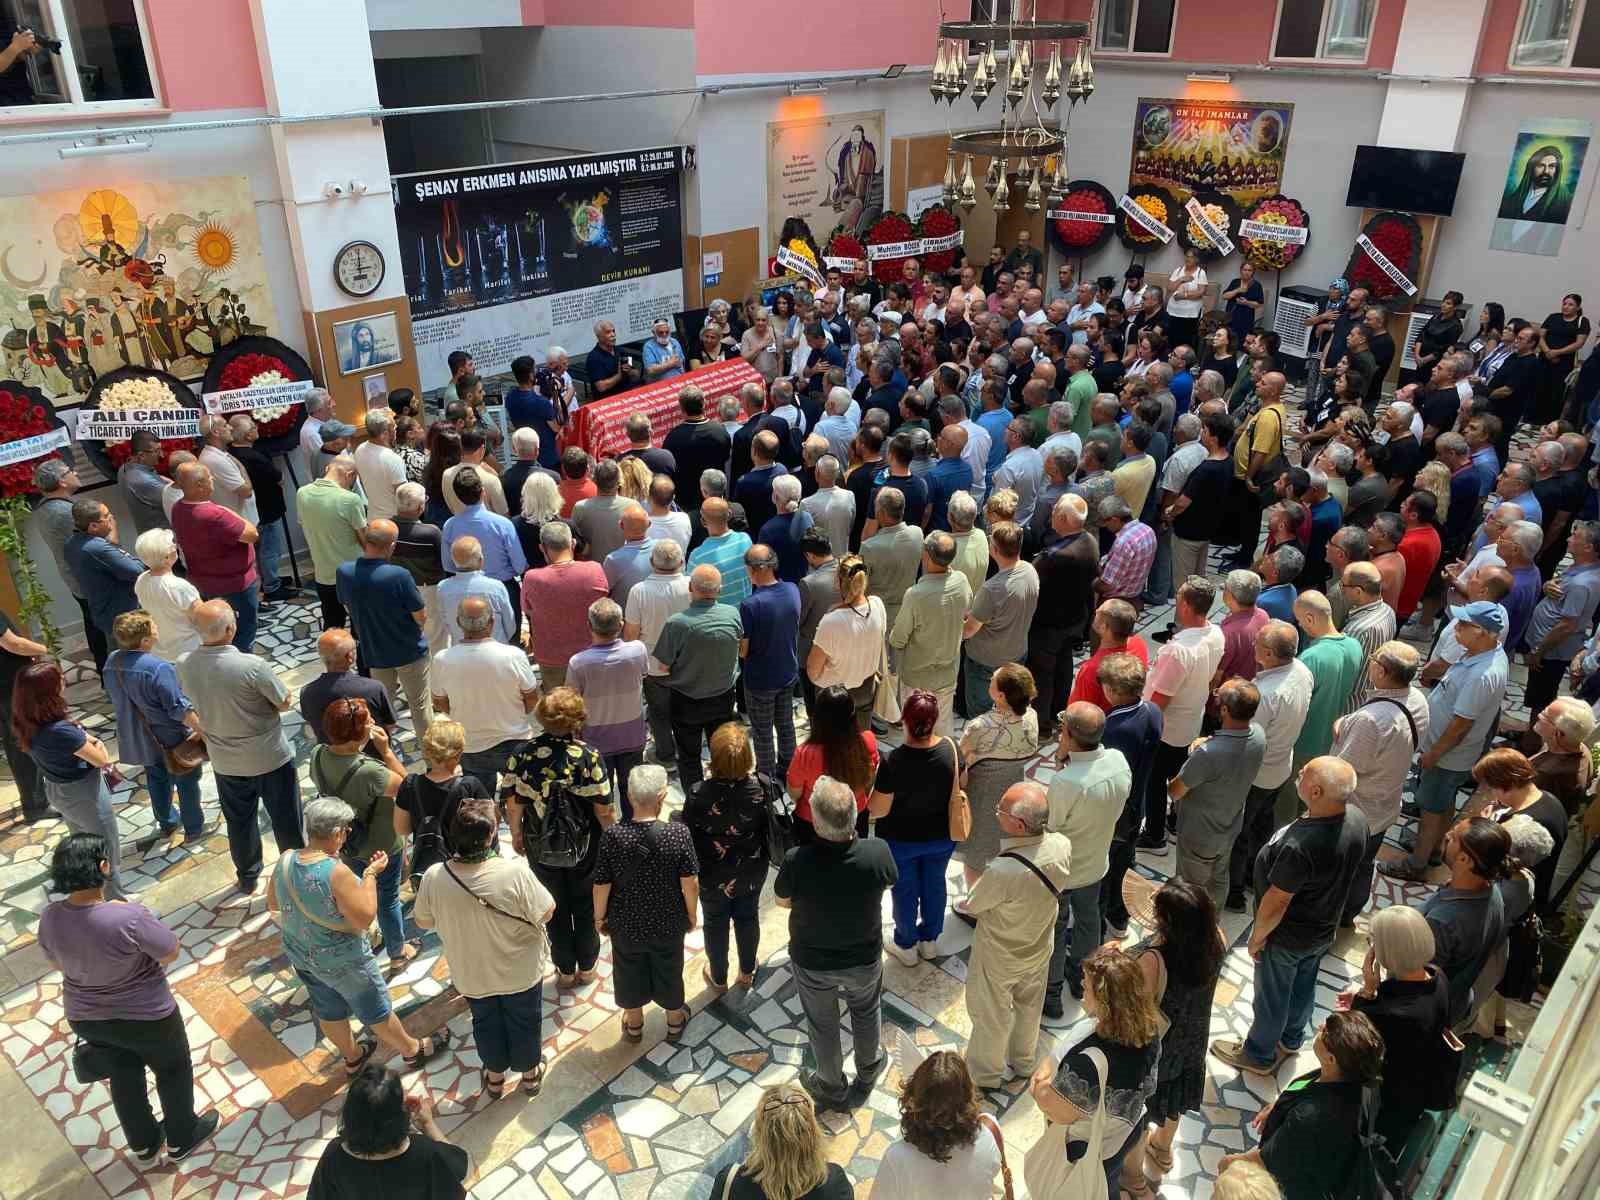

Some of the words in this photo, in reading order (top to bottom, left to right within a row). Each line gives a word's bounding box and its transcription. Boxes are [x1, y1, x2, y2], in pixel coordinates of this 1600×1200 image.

[415, 178, 459, 202] ŞENAY
[462, 172, 516, 192] ERKMEN
[519, 166, 568, 186] ANISINA
[568, 158, 637, 178] YAPILMIŞTIR
[877, 244, 901, 253] Muhittin
[220, 391, 242, 401] ANTALYA
[221, 400, 240, 411] İDRİS
[242, 399, 255, 410] TAŞ
[257, 398, 267, 406] VE
[267, 394, 292, 405] YÖNETİM
[88, 425, 123, 438] TİCARET
